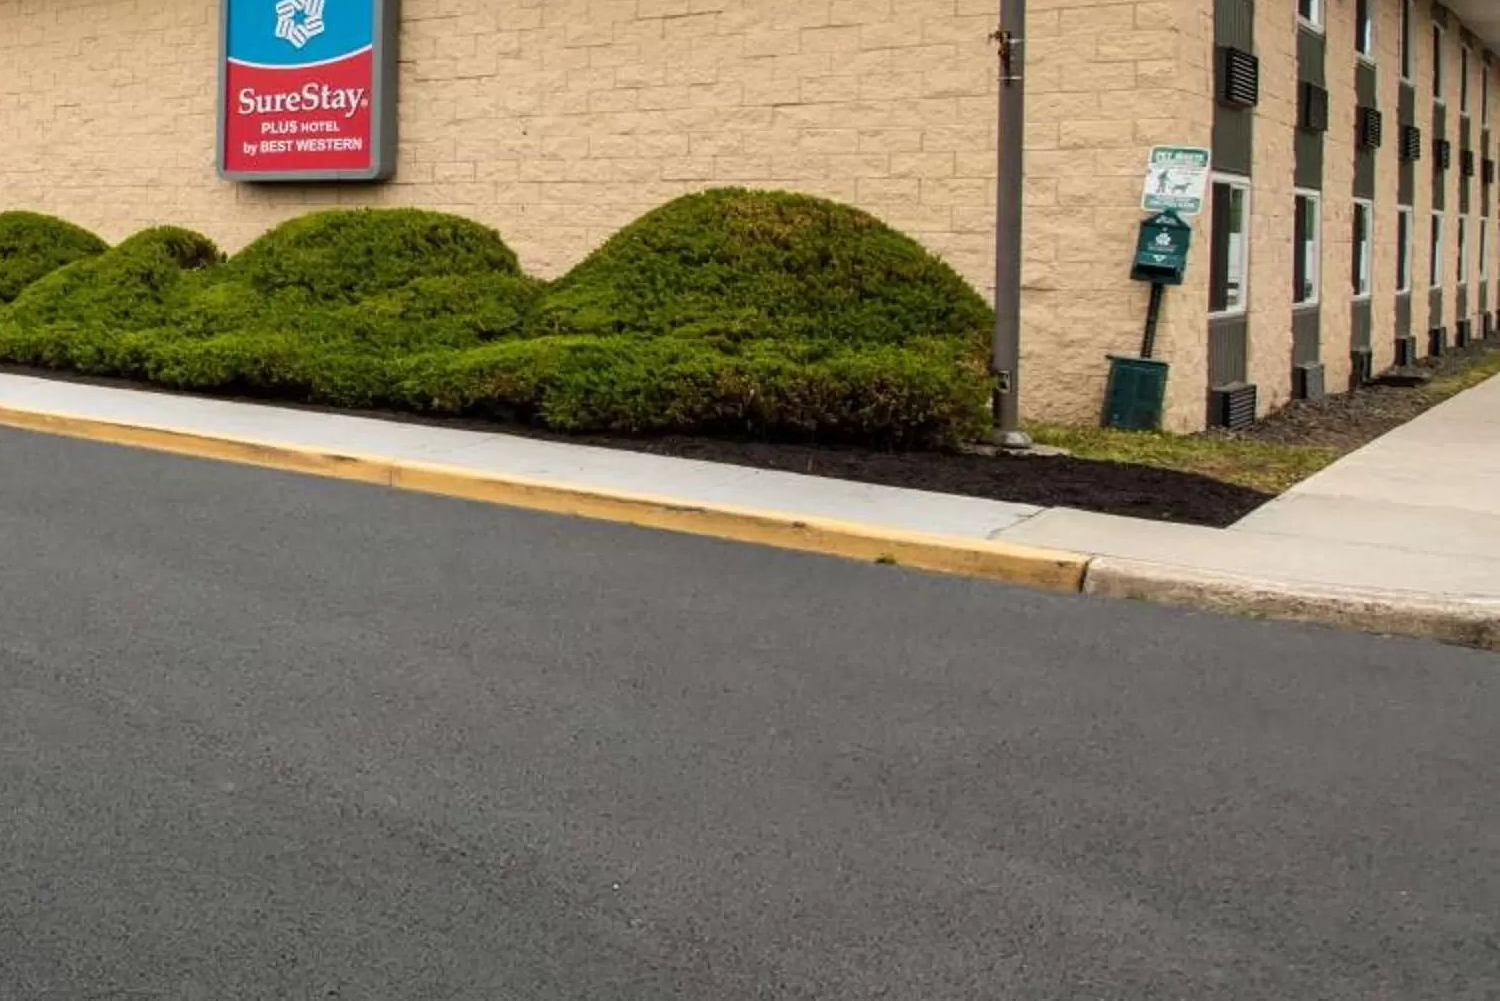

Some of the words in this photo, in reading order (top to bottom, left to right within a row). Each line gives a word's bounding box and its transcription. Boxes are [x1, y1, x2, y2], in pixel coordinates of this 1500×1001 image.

[261, 121, 298, 134] PLUS
[301, 121, 340, 132] HOTEL
[243, 142, 258, 155] by
[260, 140, 293, 153] BEST
[296, 138, 363, 152] WESTERN
